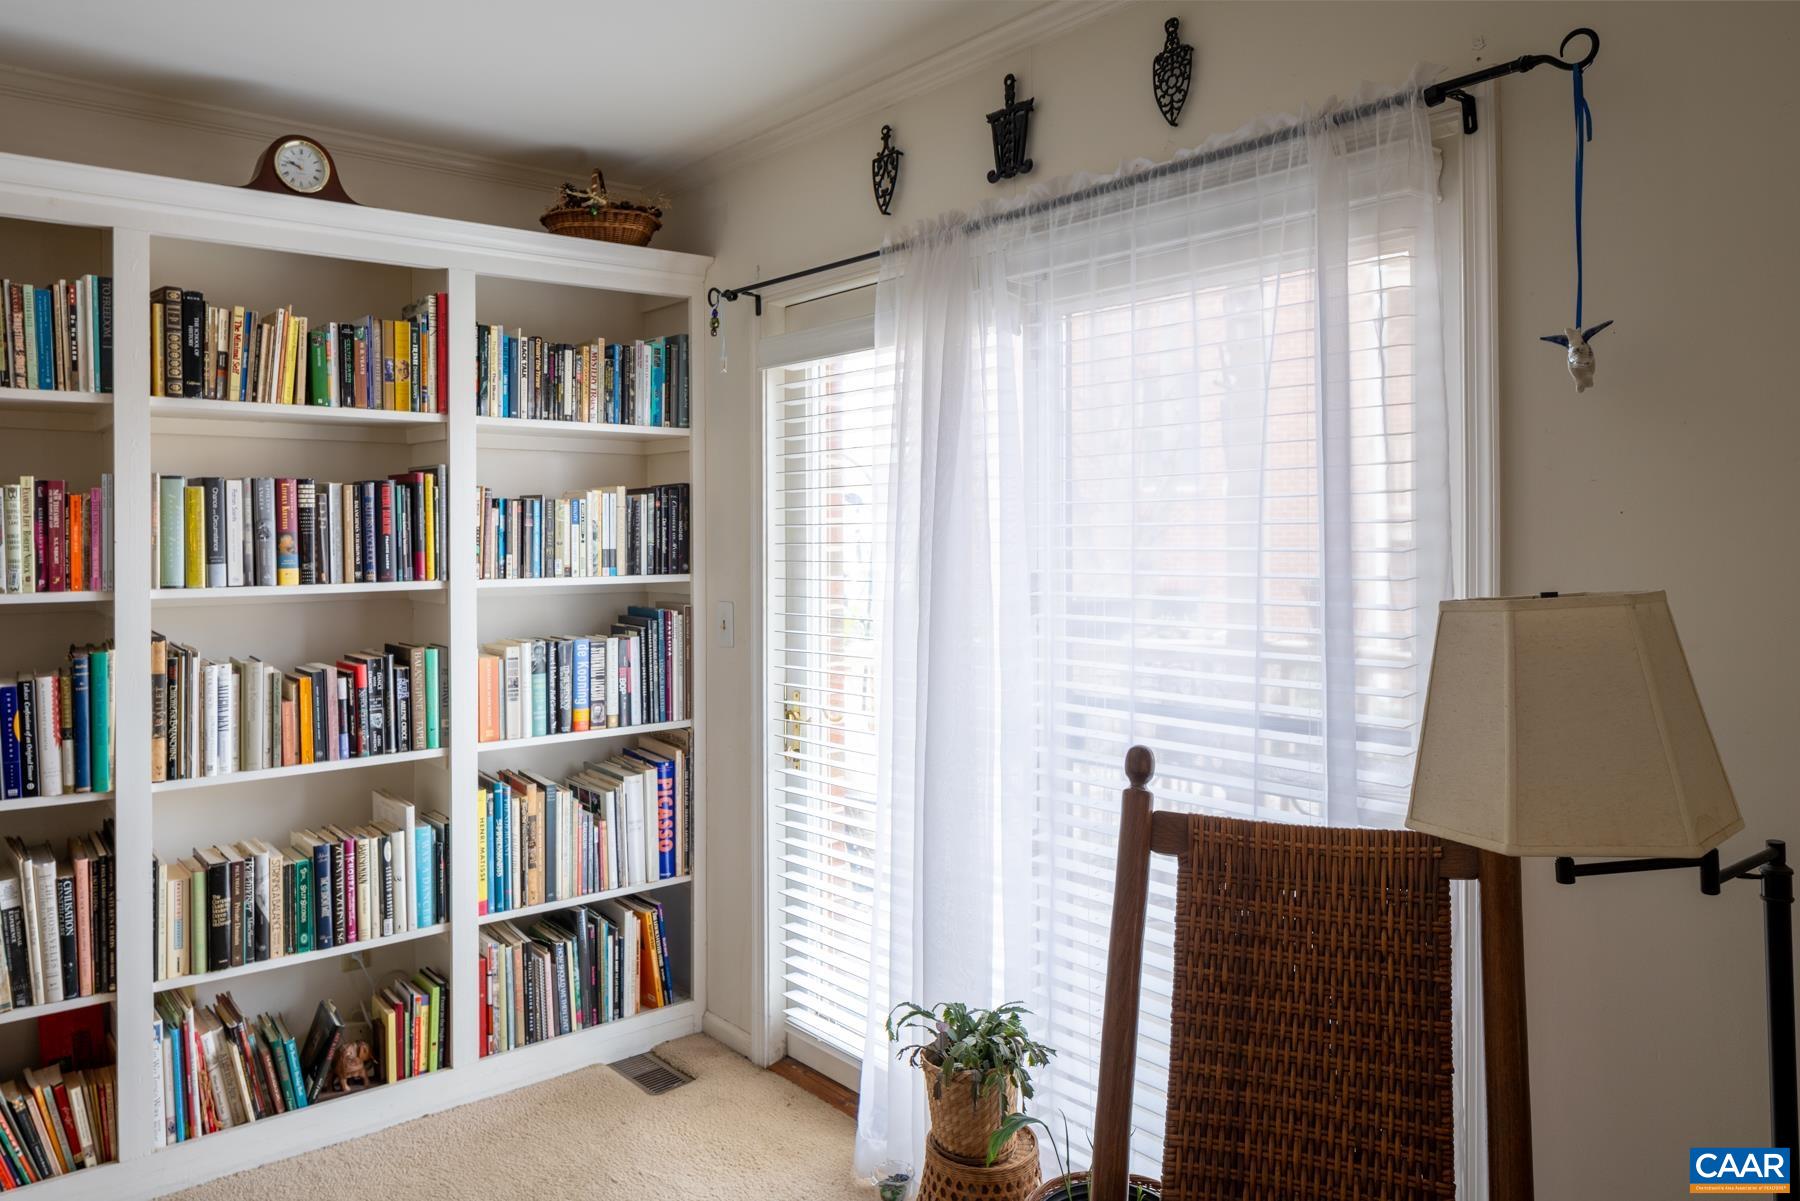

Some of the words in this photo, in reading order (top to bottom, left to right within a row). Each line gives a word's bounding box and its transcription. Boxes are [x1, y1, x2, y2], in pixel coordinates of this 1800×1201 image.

[234, 320, 242, 332] The
[233, 333, 242, 360] Minimal
[232, 362, 240, 375] Self
[578, 645, 588, 658] de
[575, 662, 589, 706] Kooning
[658, 778, 674, 852] PICASSO
[63, 880, 74, 936] CIVILISATION
[272, 900, 282, 931] BALANCE
[47, 907, 58, 968] ROOSEVELTS
[558, 963, 566, 988] SHOULD
